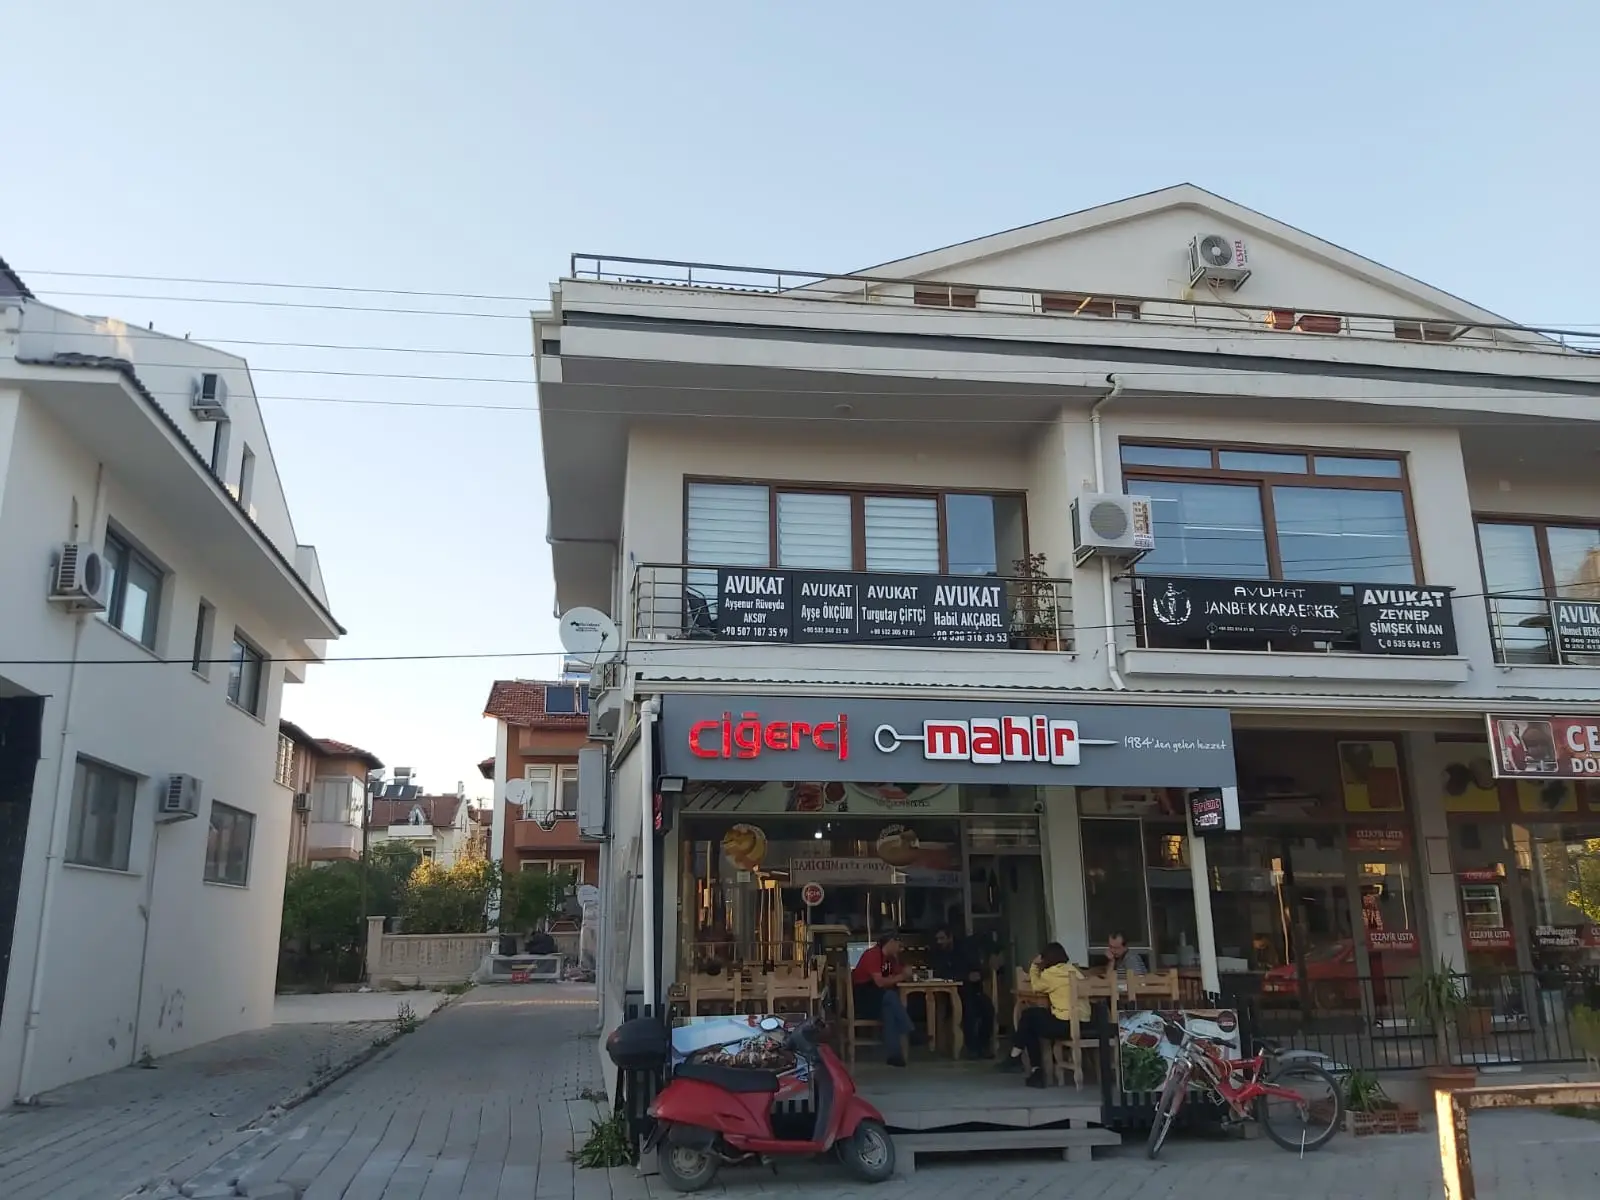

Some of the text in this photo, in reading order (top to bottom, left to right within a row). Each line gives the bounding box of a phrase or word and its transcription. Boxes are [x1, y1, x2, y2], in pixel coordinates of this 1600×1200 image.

[725, 576, 784, 594] AVUKAT
[801, 582, 852, 598] AVUKAT
[868, 585, 918, 599] AVUKAT
[1234, 586, 1306, 598] AVUKAT
[934, 585, 1000, 607] AVUKAT
[1363, 590, 1444, 607] AVUKAT
[725, 598, 785, 611] Ayşenur Rüveyda
[801, 602, 853, 622] Ayşe ÖKÇÜM
[744, 613, 766, 623] AKSOY
[862, 605, 926, 625] Turgutay ÇİFTÇİ
[934, 612, 1003, 630] Habil AKÇABEL
[1379, 609, 1430, 621] ZEYNEP
[721, 627, 788, 637] +90 507 187 35 99
[1370, 620, 1443, 636] ŞİMŞEK İNAN
[997, 633, 1008, 642] 53
[1393, 640, 1406, 648] 535
[1407, 640, 1421, 648] 654
[1432, 641, 1441, 649] 15
[926, 718, 1074, 758] mahir
[1124, 735, 1227, 753] 1984'den gelen lezzet
[1571, 753, 1600, 773] DÖ
